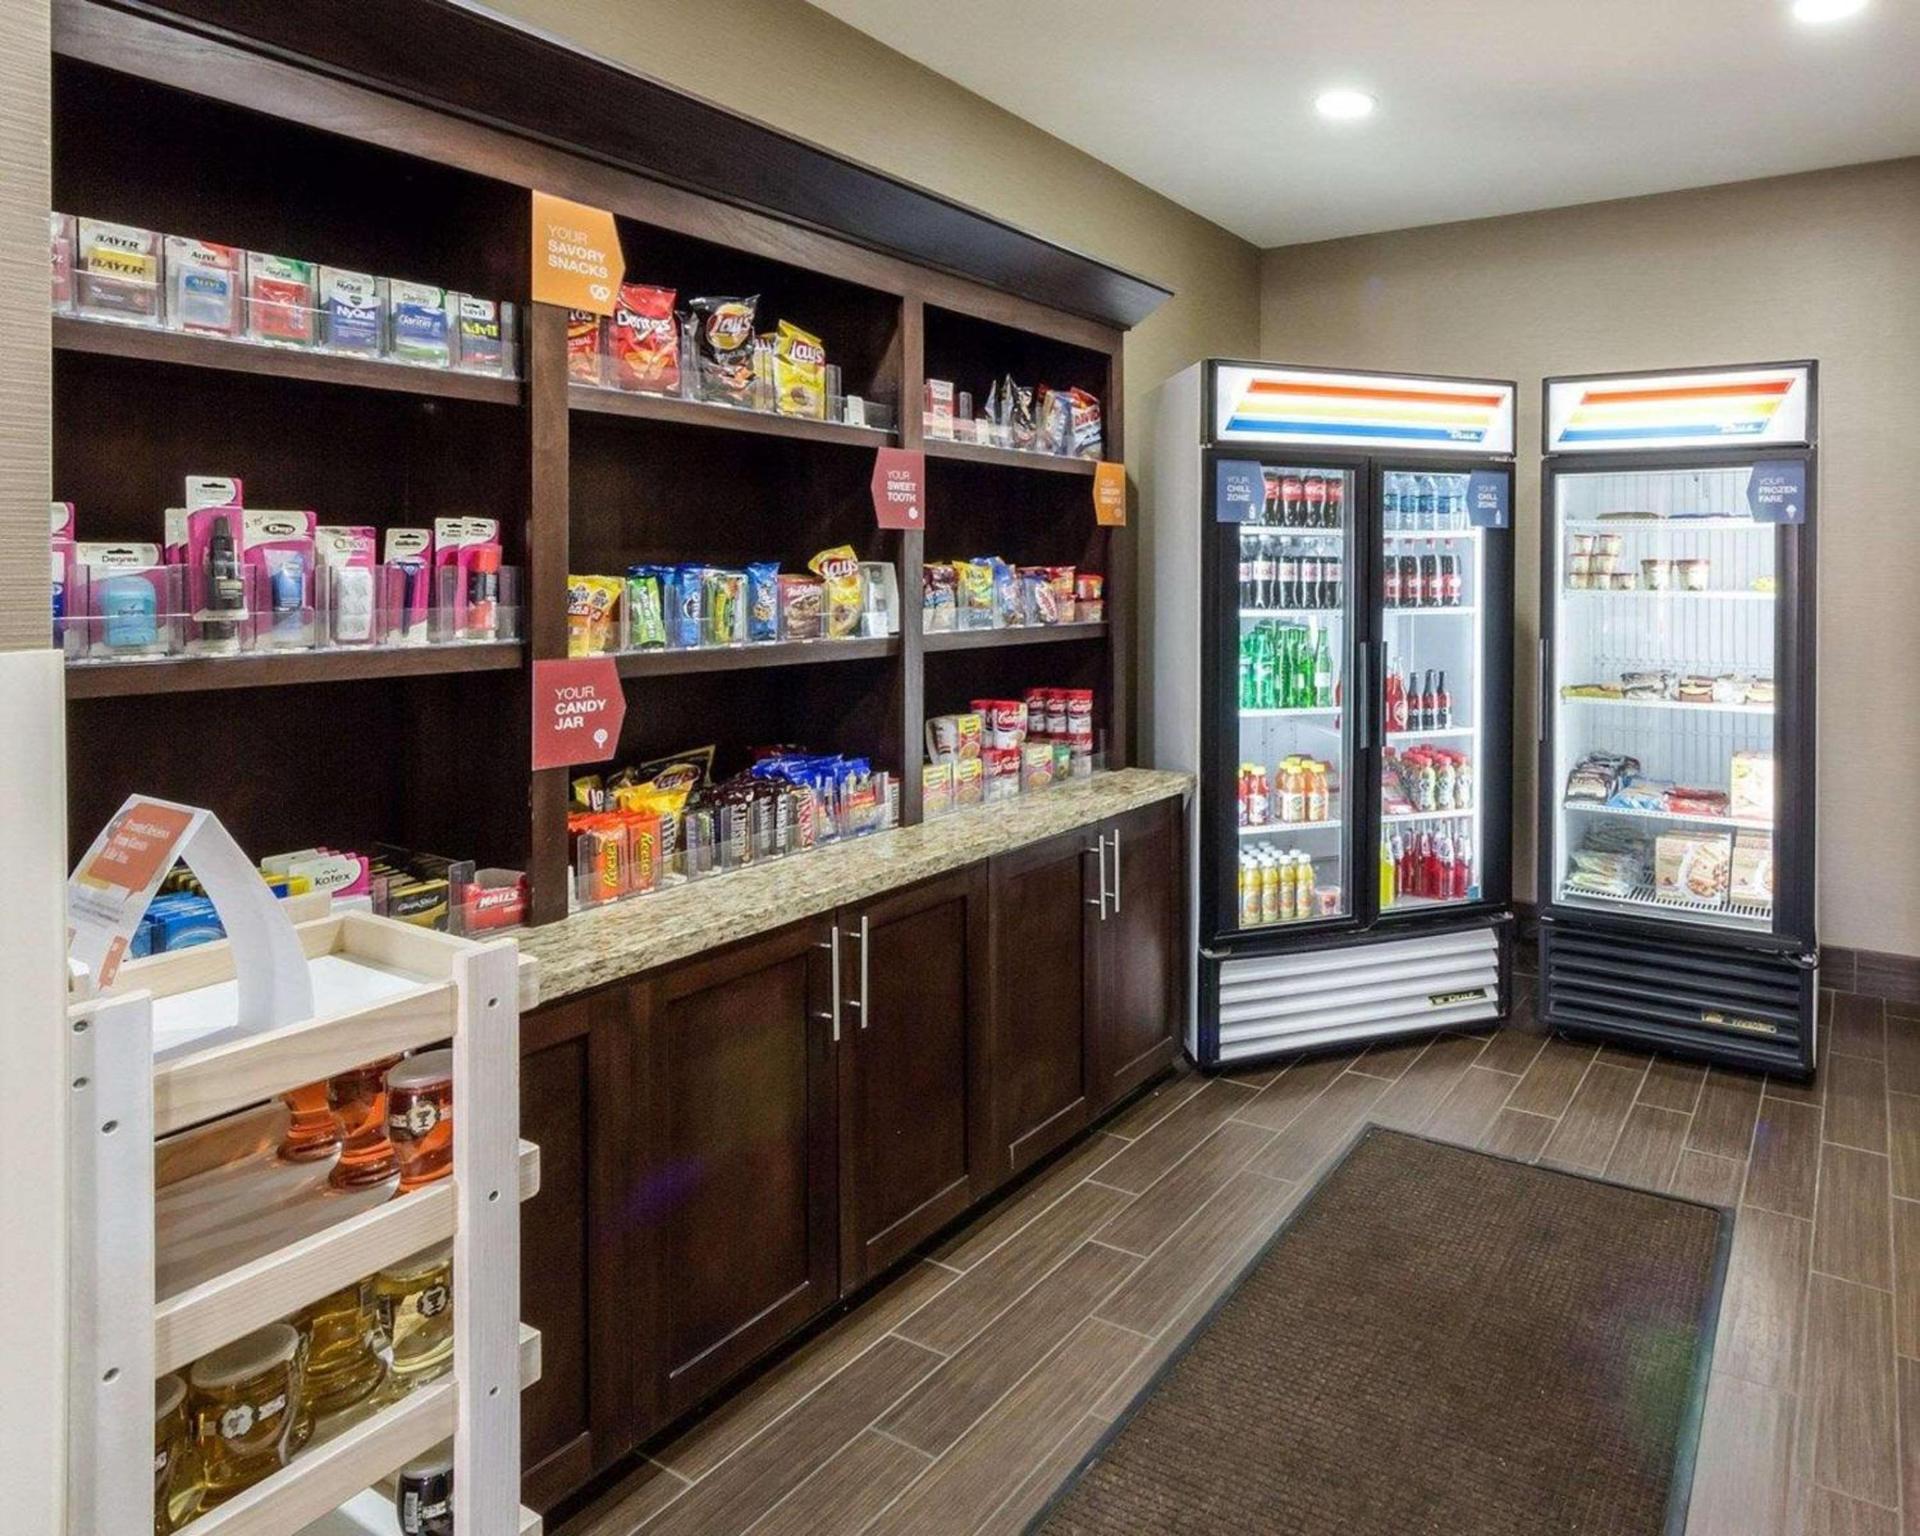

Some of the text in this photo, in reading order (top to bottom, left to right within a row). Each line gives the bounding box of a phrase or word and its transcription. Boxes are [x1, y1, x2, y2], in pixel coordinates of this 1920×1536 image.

[547, 224, 588, 245] YOUR
[547, 239, 606, 263] SAVORY
[547, 254, 609, 279] SNACKS
[336, 305, 376, 320] NyQuil
[461, 321, 499, 337] Advil
[616, 309, 671, 338] Doritos
[886, 470, 910, 480] YOUR
[1227, 476, 1249, 484] YOUR
[887, 480, 916, 491] SWEET
[1227, 484, 1251, 493] CHILL
[1758, 485, 1798, 494] FROZEN
[887, 491, 916, 502] TOOTH
[1227, 493, 1250, 502] ZONE
[1758, 494, 1784, 503] FARE
[554, 686, 595, 700] YOUR
[554, 699, 607, 715] CANDY
[554, 716, 584, 731] JAR
[315, 871, 352, 887] kotex
[479, 891, 519, 909] HALLS
